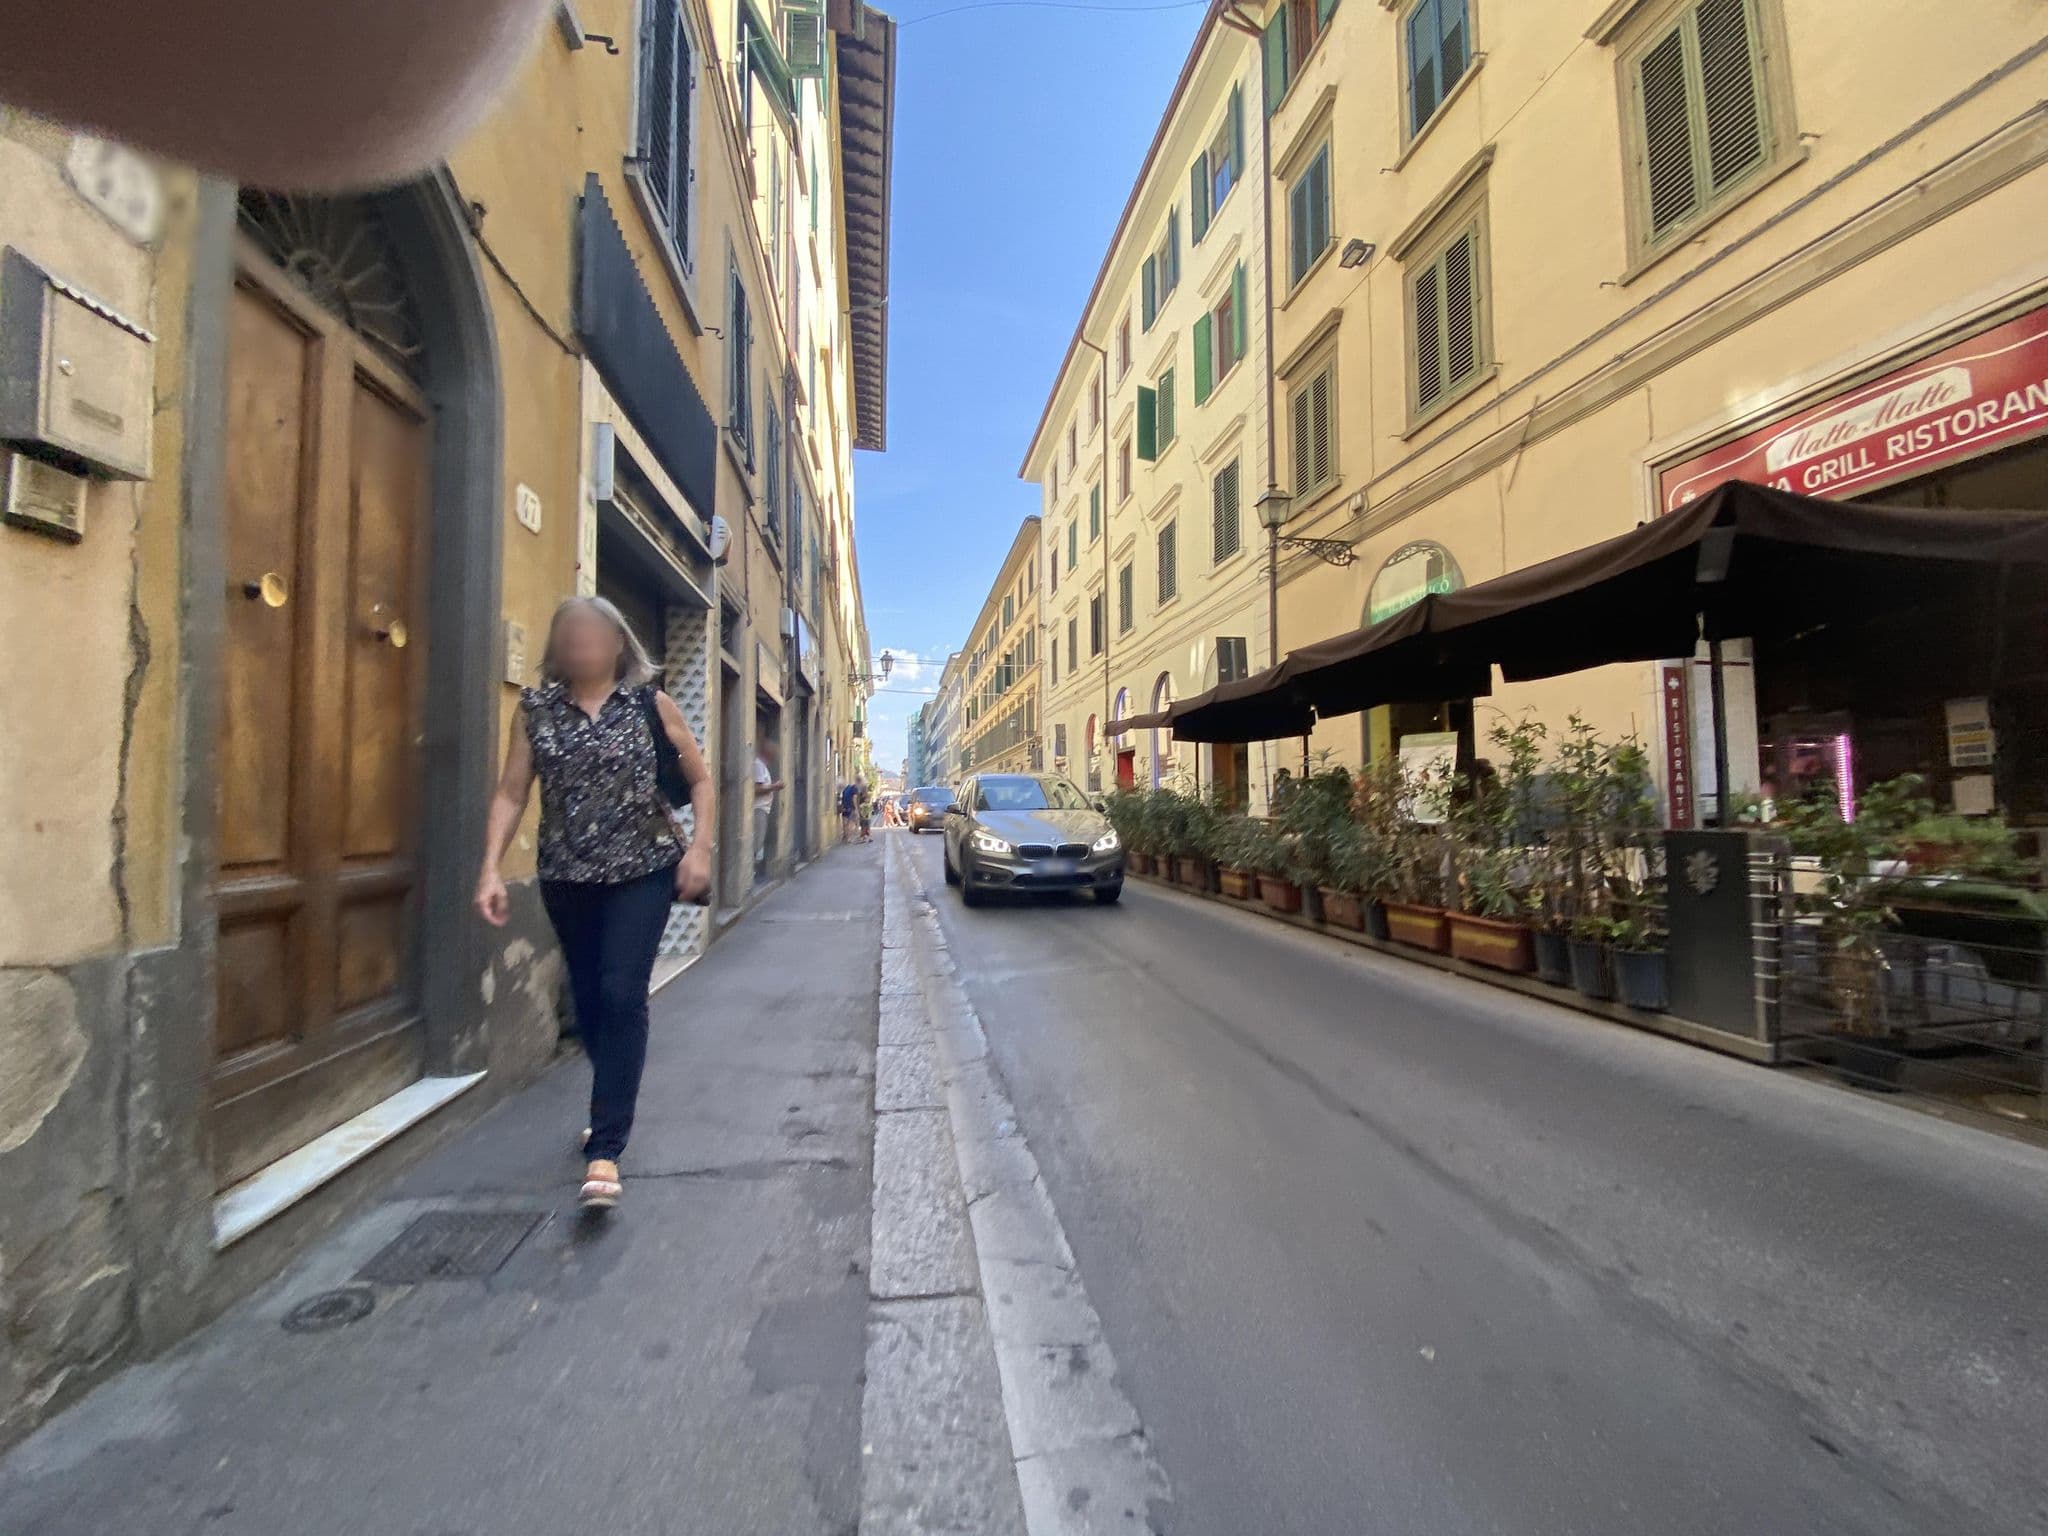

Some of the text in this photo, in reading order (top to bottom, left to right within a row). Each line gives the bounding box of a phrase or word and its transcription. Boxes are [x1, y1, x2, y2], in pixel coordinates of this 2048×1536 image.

[1784, 381, 1955, 464] Matto Matto
[1803, 447, 1876, 489] GRILL
[1887, 378, 2048, 461] RISTORAN
[1671, 698, 1686, 820] RISTORANTE
